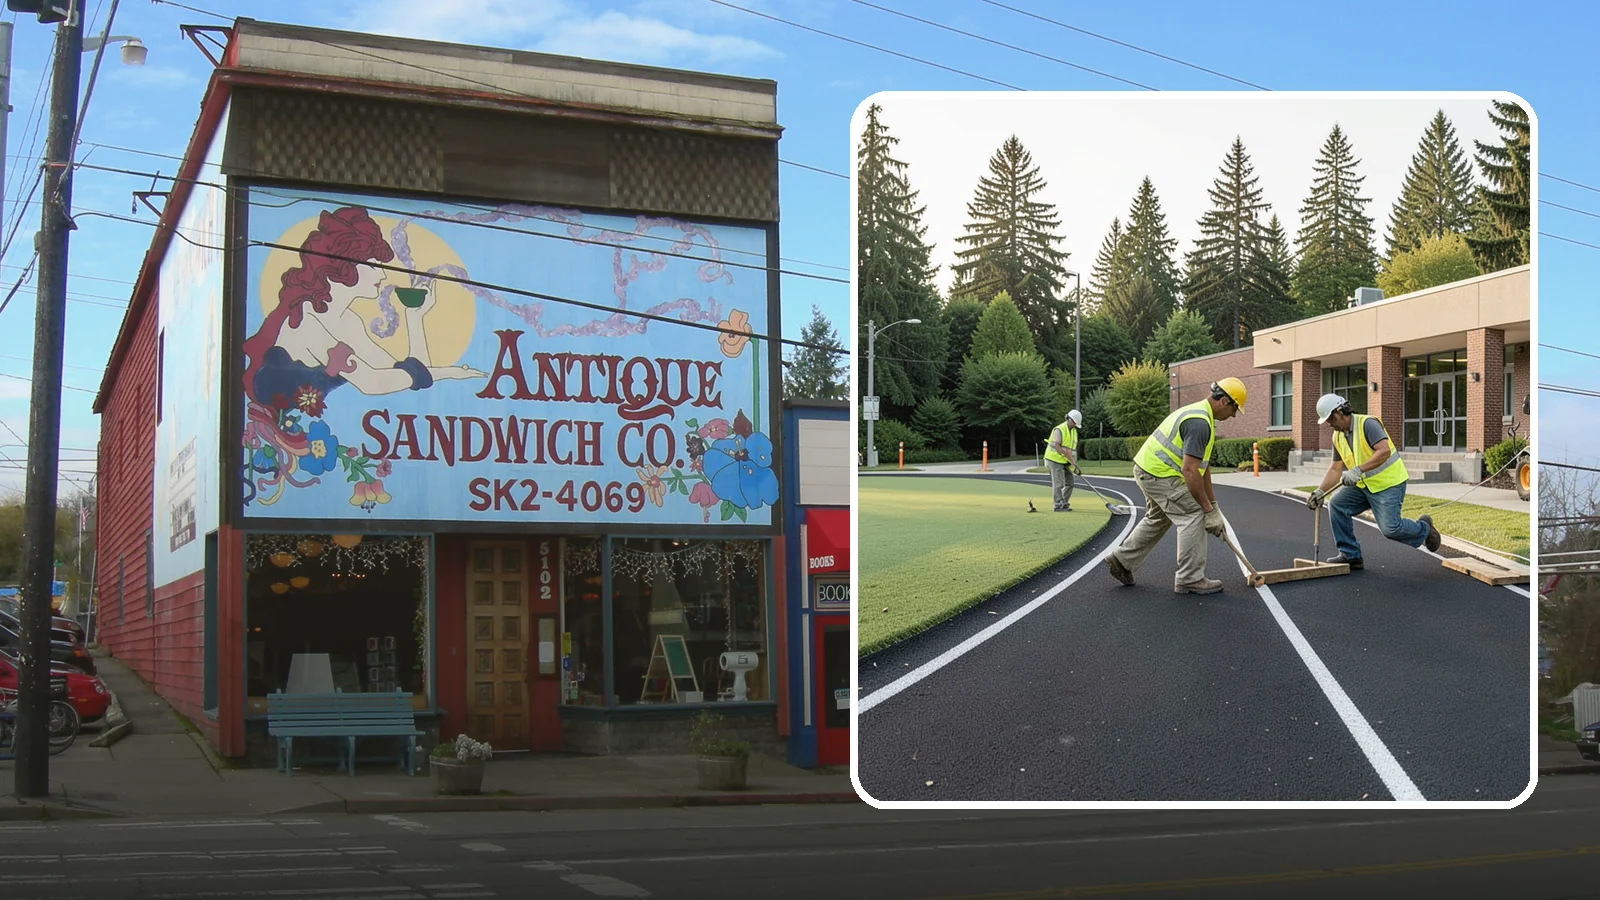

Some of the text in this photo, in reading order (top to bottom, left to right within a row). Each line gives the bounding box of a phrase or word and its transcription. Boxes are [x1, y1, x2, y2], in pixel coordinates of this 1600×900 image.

[475, 329, 724, 420] ANTIQUE
[361, 408, 685, 469] SANDWICH CO.
[468, 477, 646, 513] SK2-4069
[540, 541, 551, 600] 5102
[809, 555, 835, 569] BOOKS
